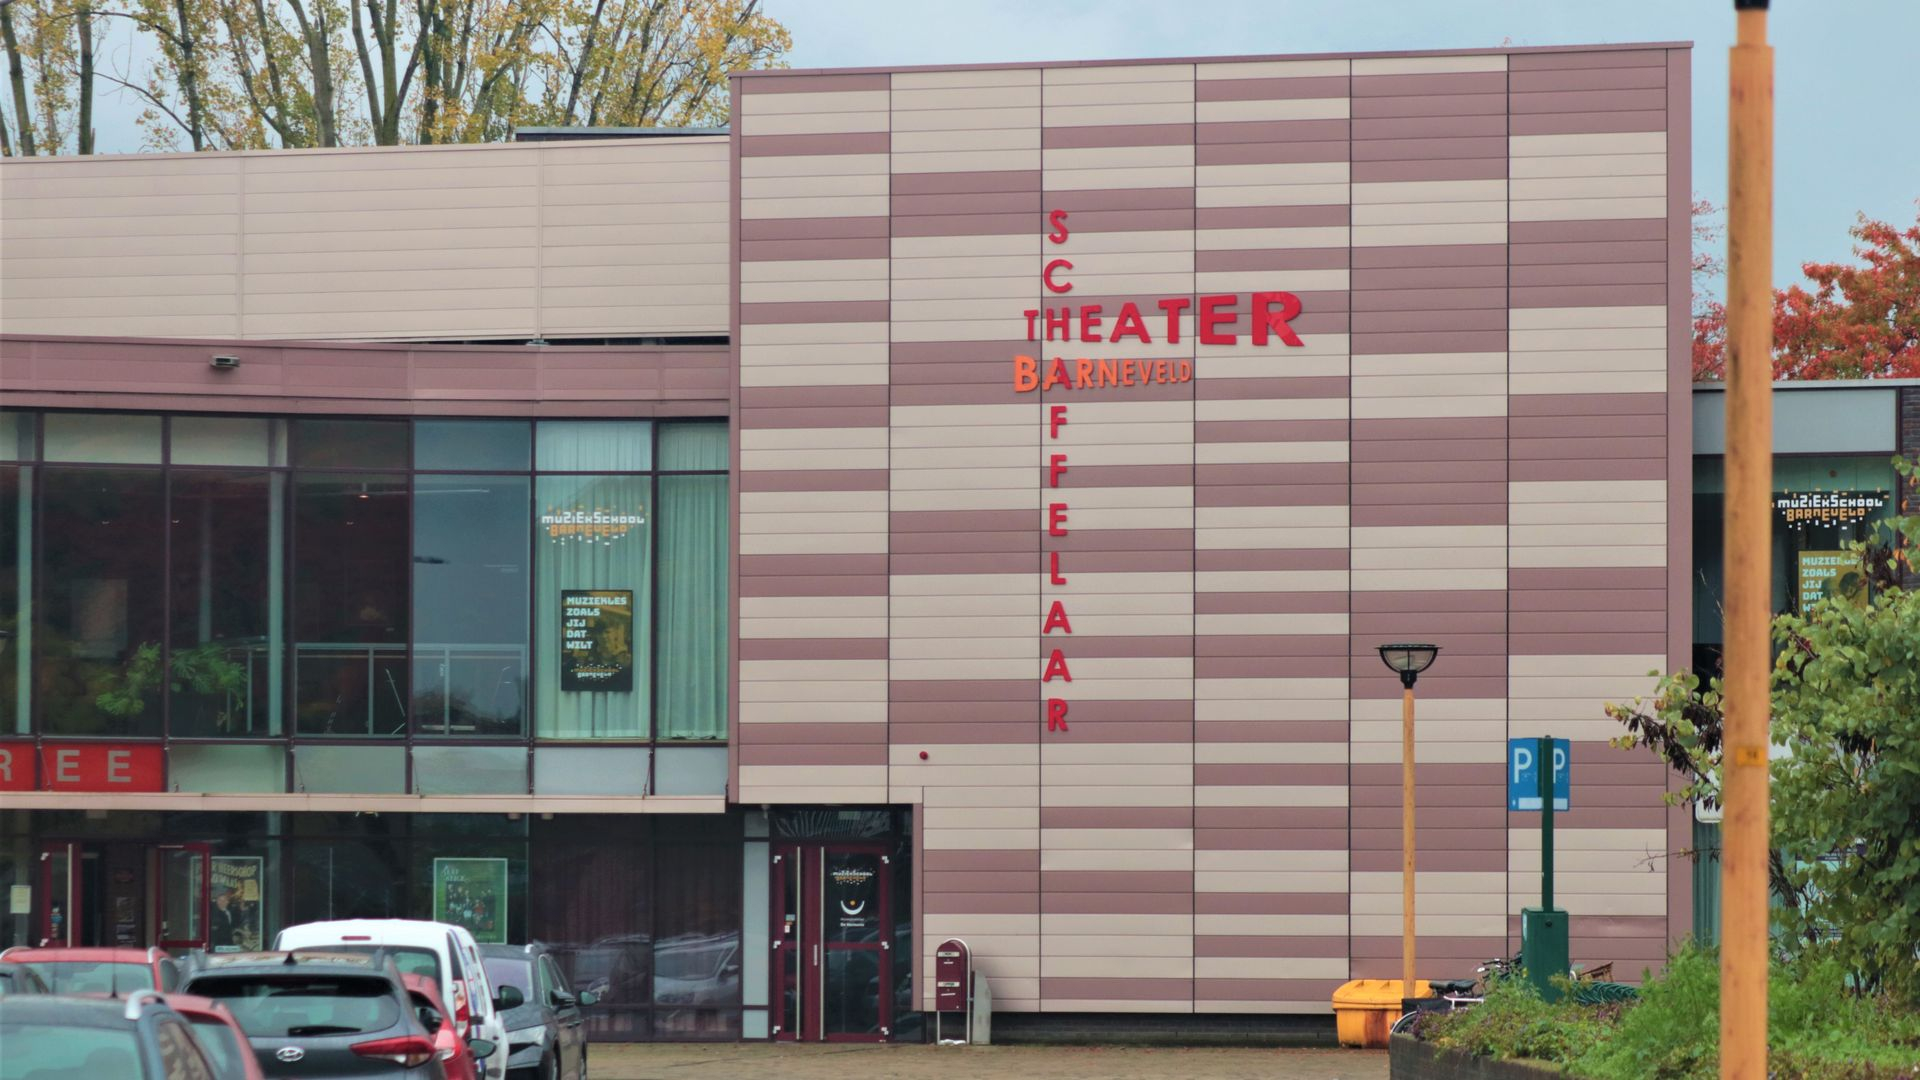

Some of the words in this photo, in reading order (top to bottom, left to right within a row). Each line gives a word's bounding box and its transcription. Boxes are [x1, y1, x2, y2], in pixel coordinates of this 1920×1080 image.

[1024, 291, 1305, 347] THEATER
[1014, 355, 1193, 392] BARNEVELD
[1802, 568, 1837, 577] ZOALS
[1802, 580, 1822, 589] JIJ
[566, 596, 627, 605] MUZIEKLES
[1802, 591, 1824, 600] DAT
[566, 607, 600, 617] ZOALS
[566, 618, 586, 628] JIJ
[566, 629, 587, 639] DAT
[566, 640, 593, 650] WILT
[1514, 747, 1533, 784] P
[1553, 747, 1566, 784] P
